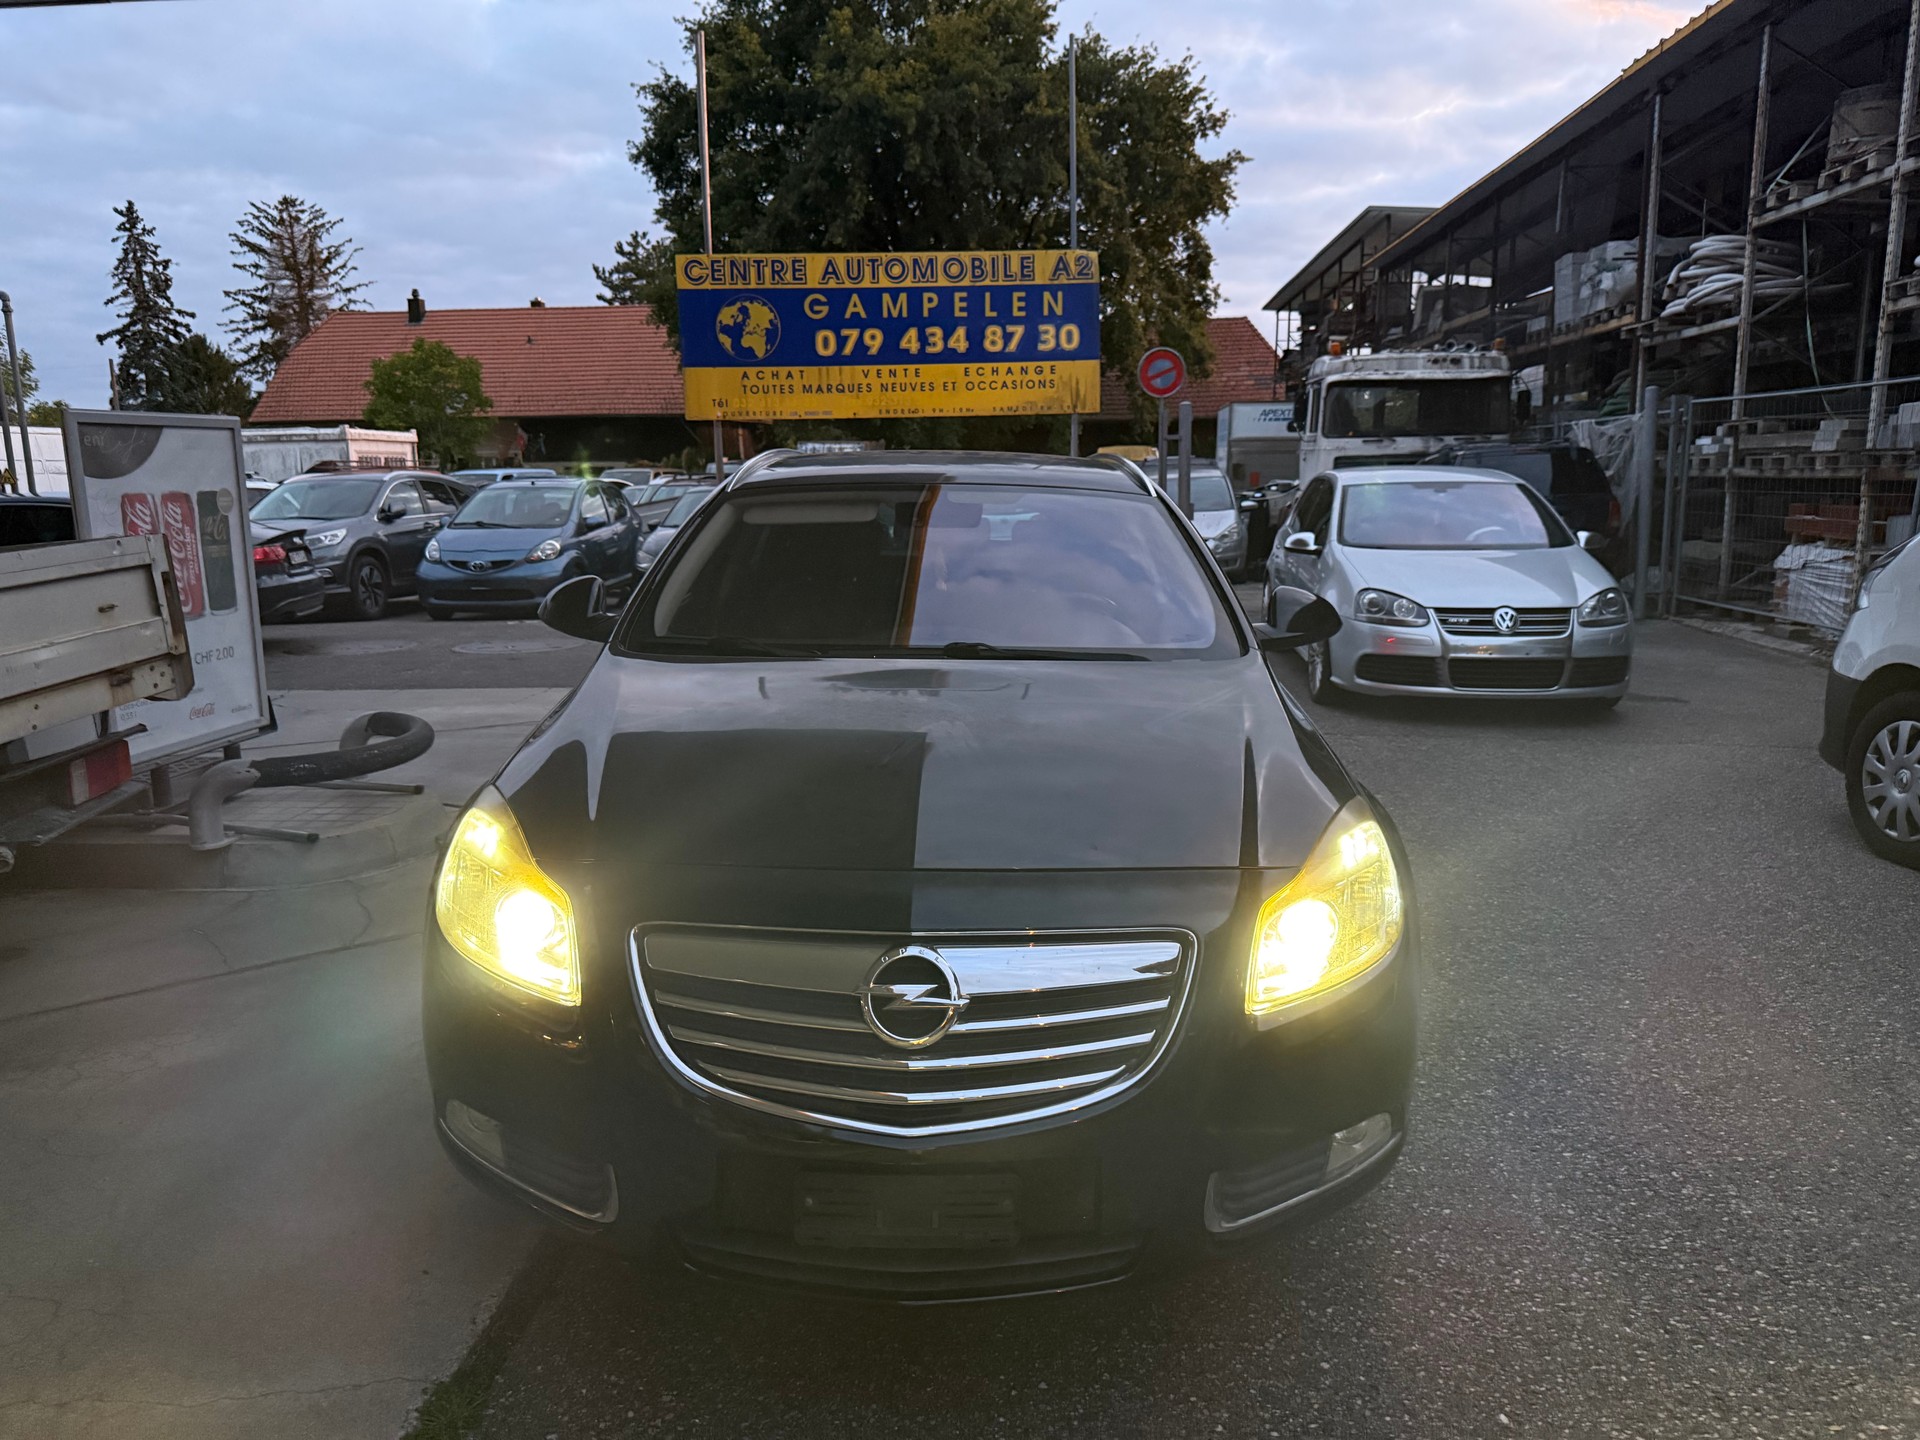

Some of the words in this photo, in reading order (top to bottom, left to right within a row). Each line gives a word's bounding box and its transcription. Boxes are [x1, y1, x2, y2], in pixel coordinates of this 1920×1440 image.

[683, 256, 807, 286] CENTRE
[818, 254, 1035, 285] AUTOMOBILE
[1049, 253, 1095, 281] A2
[803, 290, 1064, 319] GAMPELEN
[815, 328, 884, 357] 079
[899, 325, 969, 355] 434
[983, 324, 1026, 353] 87
[1037, 323, 1081, 352] 30
[741, 369, 805, 381] ACHAT
[862, 367, 921, 379] VENTE
[964, 365, 1057, 378] ECHANGE
[742, 384, 795, 395] TOUTES
[802, 383, 873, 394] MARQUES
[880, 381, 935, 393] NEUVES
[943, 381, 957, 392] ET
[965, 379, 1056, 391] OCCASIONS
[194, 650, 213, 664] CHF
[215, 646, 235, 661] 2.00
